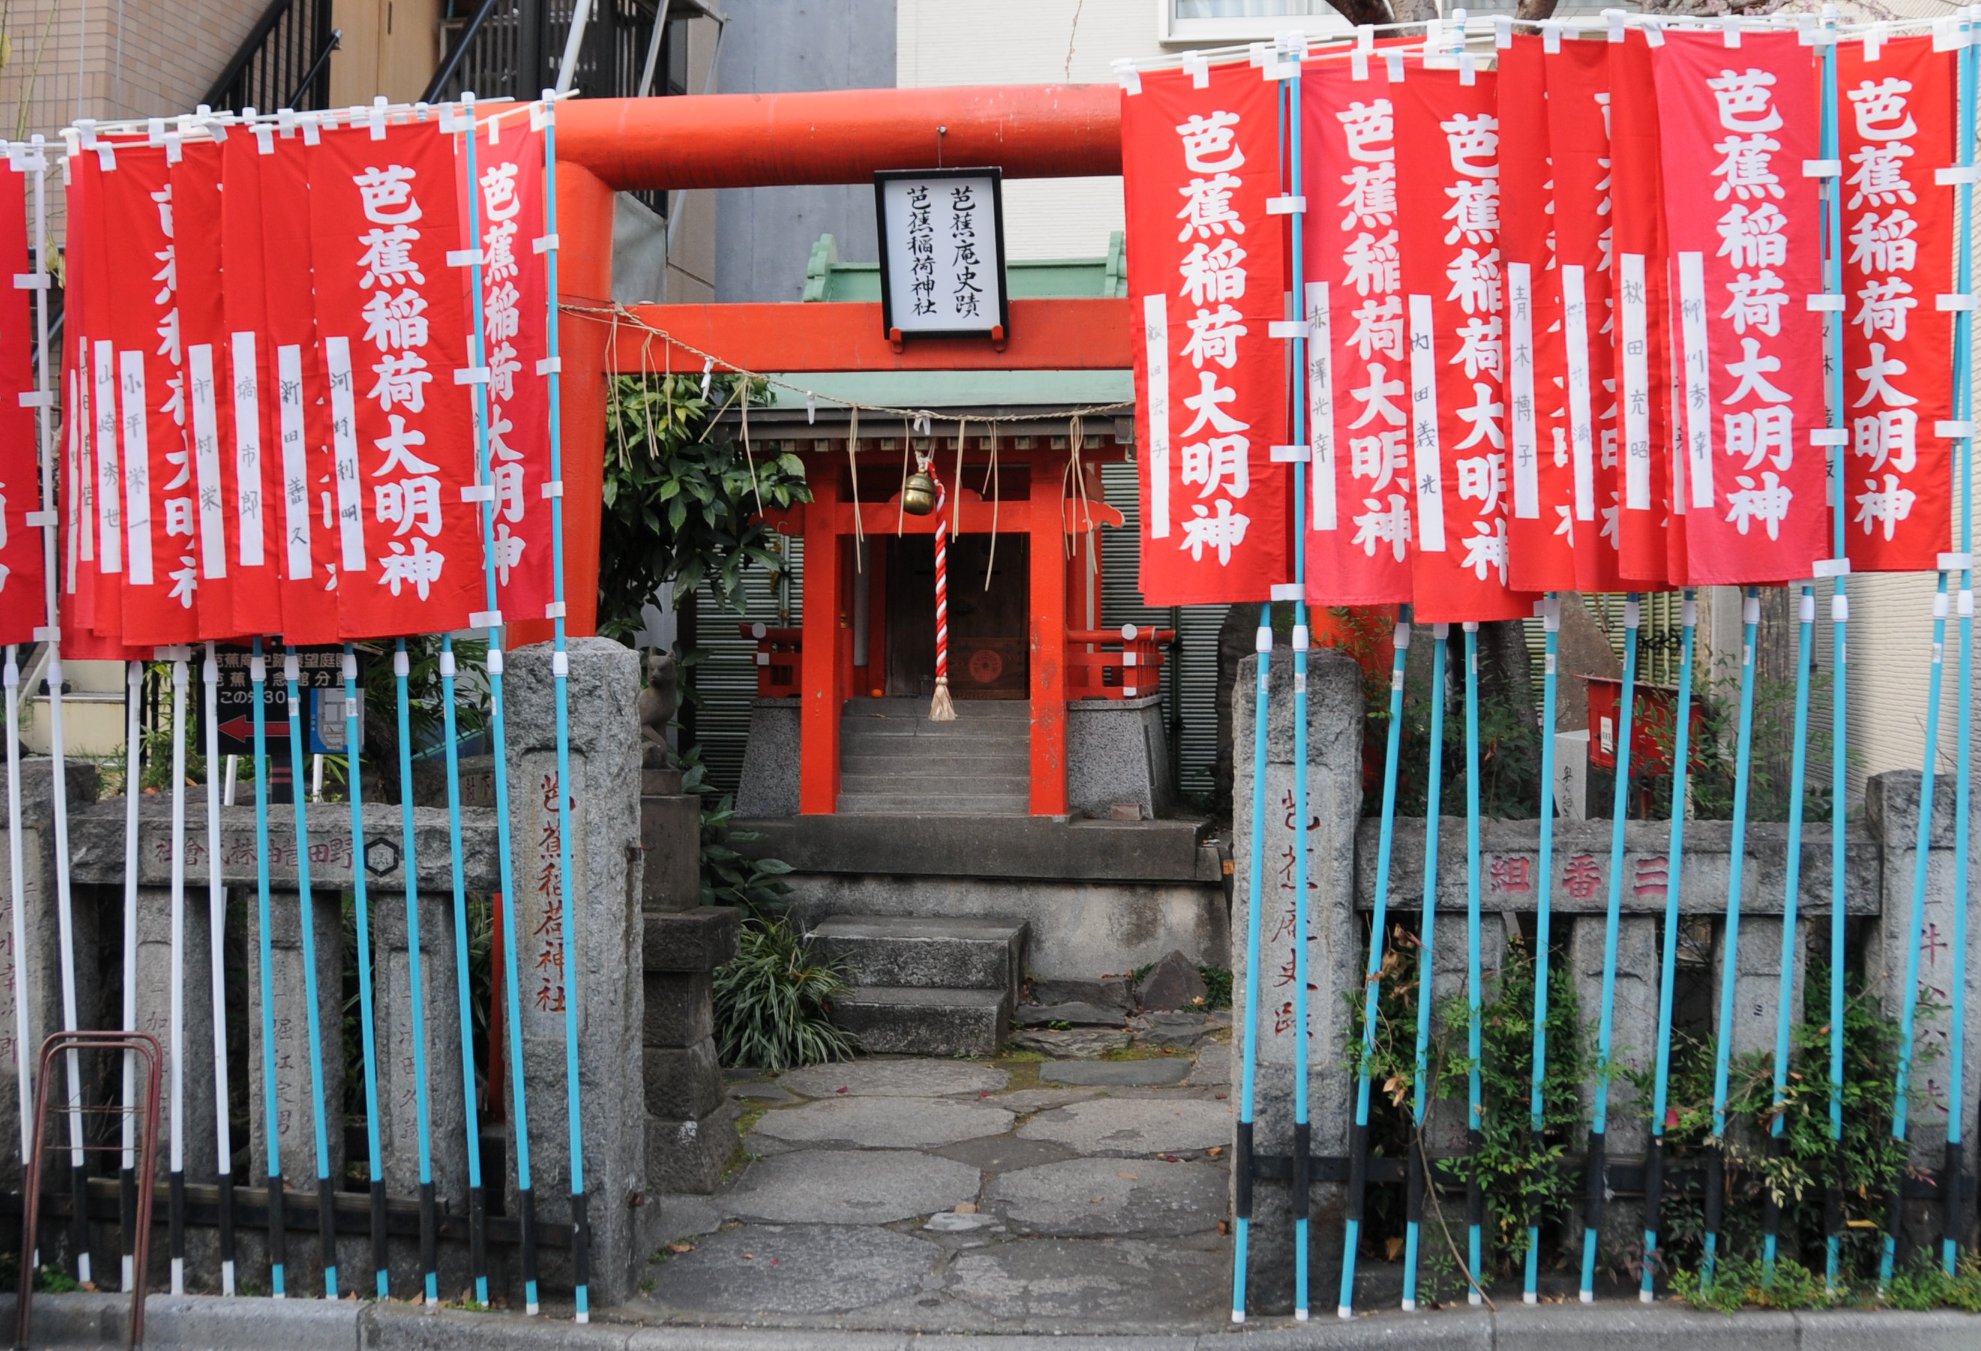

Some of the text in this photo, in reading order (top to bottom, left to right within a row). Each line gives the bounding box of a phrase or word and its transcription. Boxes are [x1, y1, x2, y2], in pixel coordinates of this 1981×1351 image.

[352, 163, 446, 602] 芭蕉稲荷大明神
[479, 161, 529, 589] 芭蕉稲荷大明神
[905, 185, 938, 317] 芭蕉稲荷神社
[949, 186, 984, 319] 芭蕉庵史蹟
[1175, 110, 1251, 568] 芭蕉稲荷大明神
[1335, 98, 1412, 565] 芭蕉稲荷大明神
[1439, 112, 1511, 590] 芭蕉稲荷大明神
[1707, 67, 1795, 543] 芭蕉稲荷大明神
[1845, 76, 1919, 543] 芭蕉稲荷大明神
